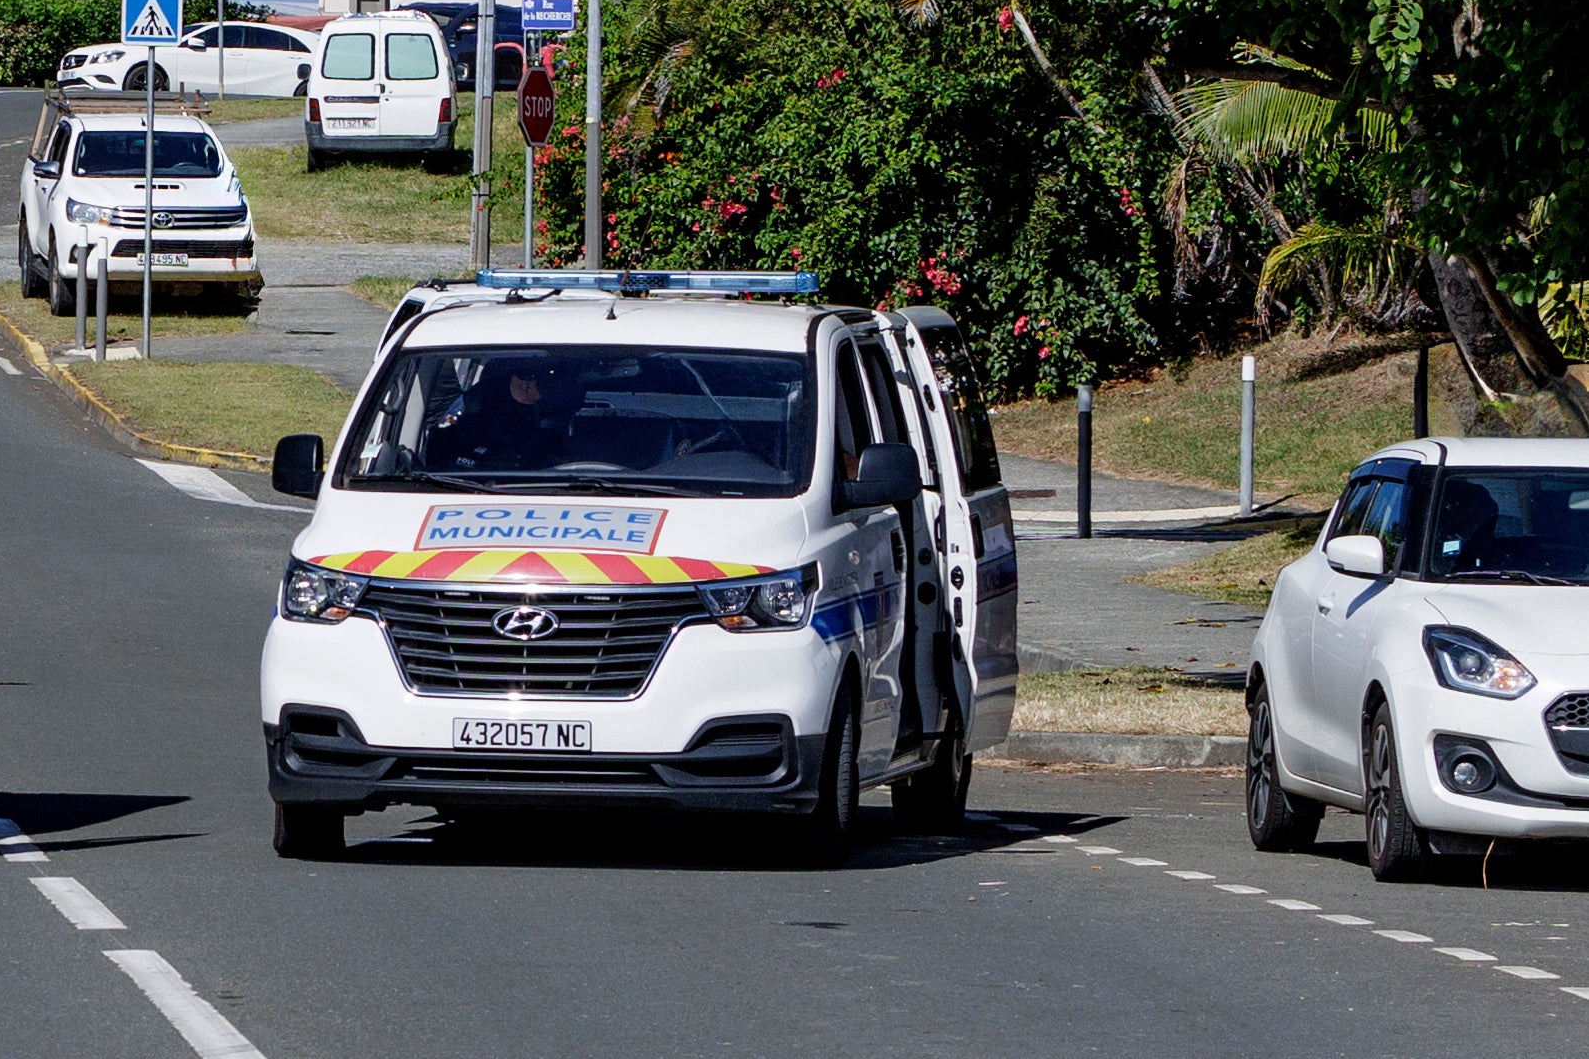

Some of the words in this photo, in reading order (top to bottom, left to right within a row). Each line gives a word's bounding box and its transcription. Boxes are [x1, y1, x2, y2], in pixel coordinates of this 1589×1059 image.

[542, 0, 555, 9] Rue
[524, 95, 552, 118] STOP
[436, 509, 653, 525] POLICE
[429, 526, 647, 543] MUNICIPALE
[460, 721, 548, 747] 432057
[557, 724, 585, 748] NC
